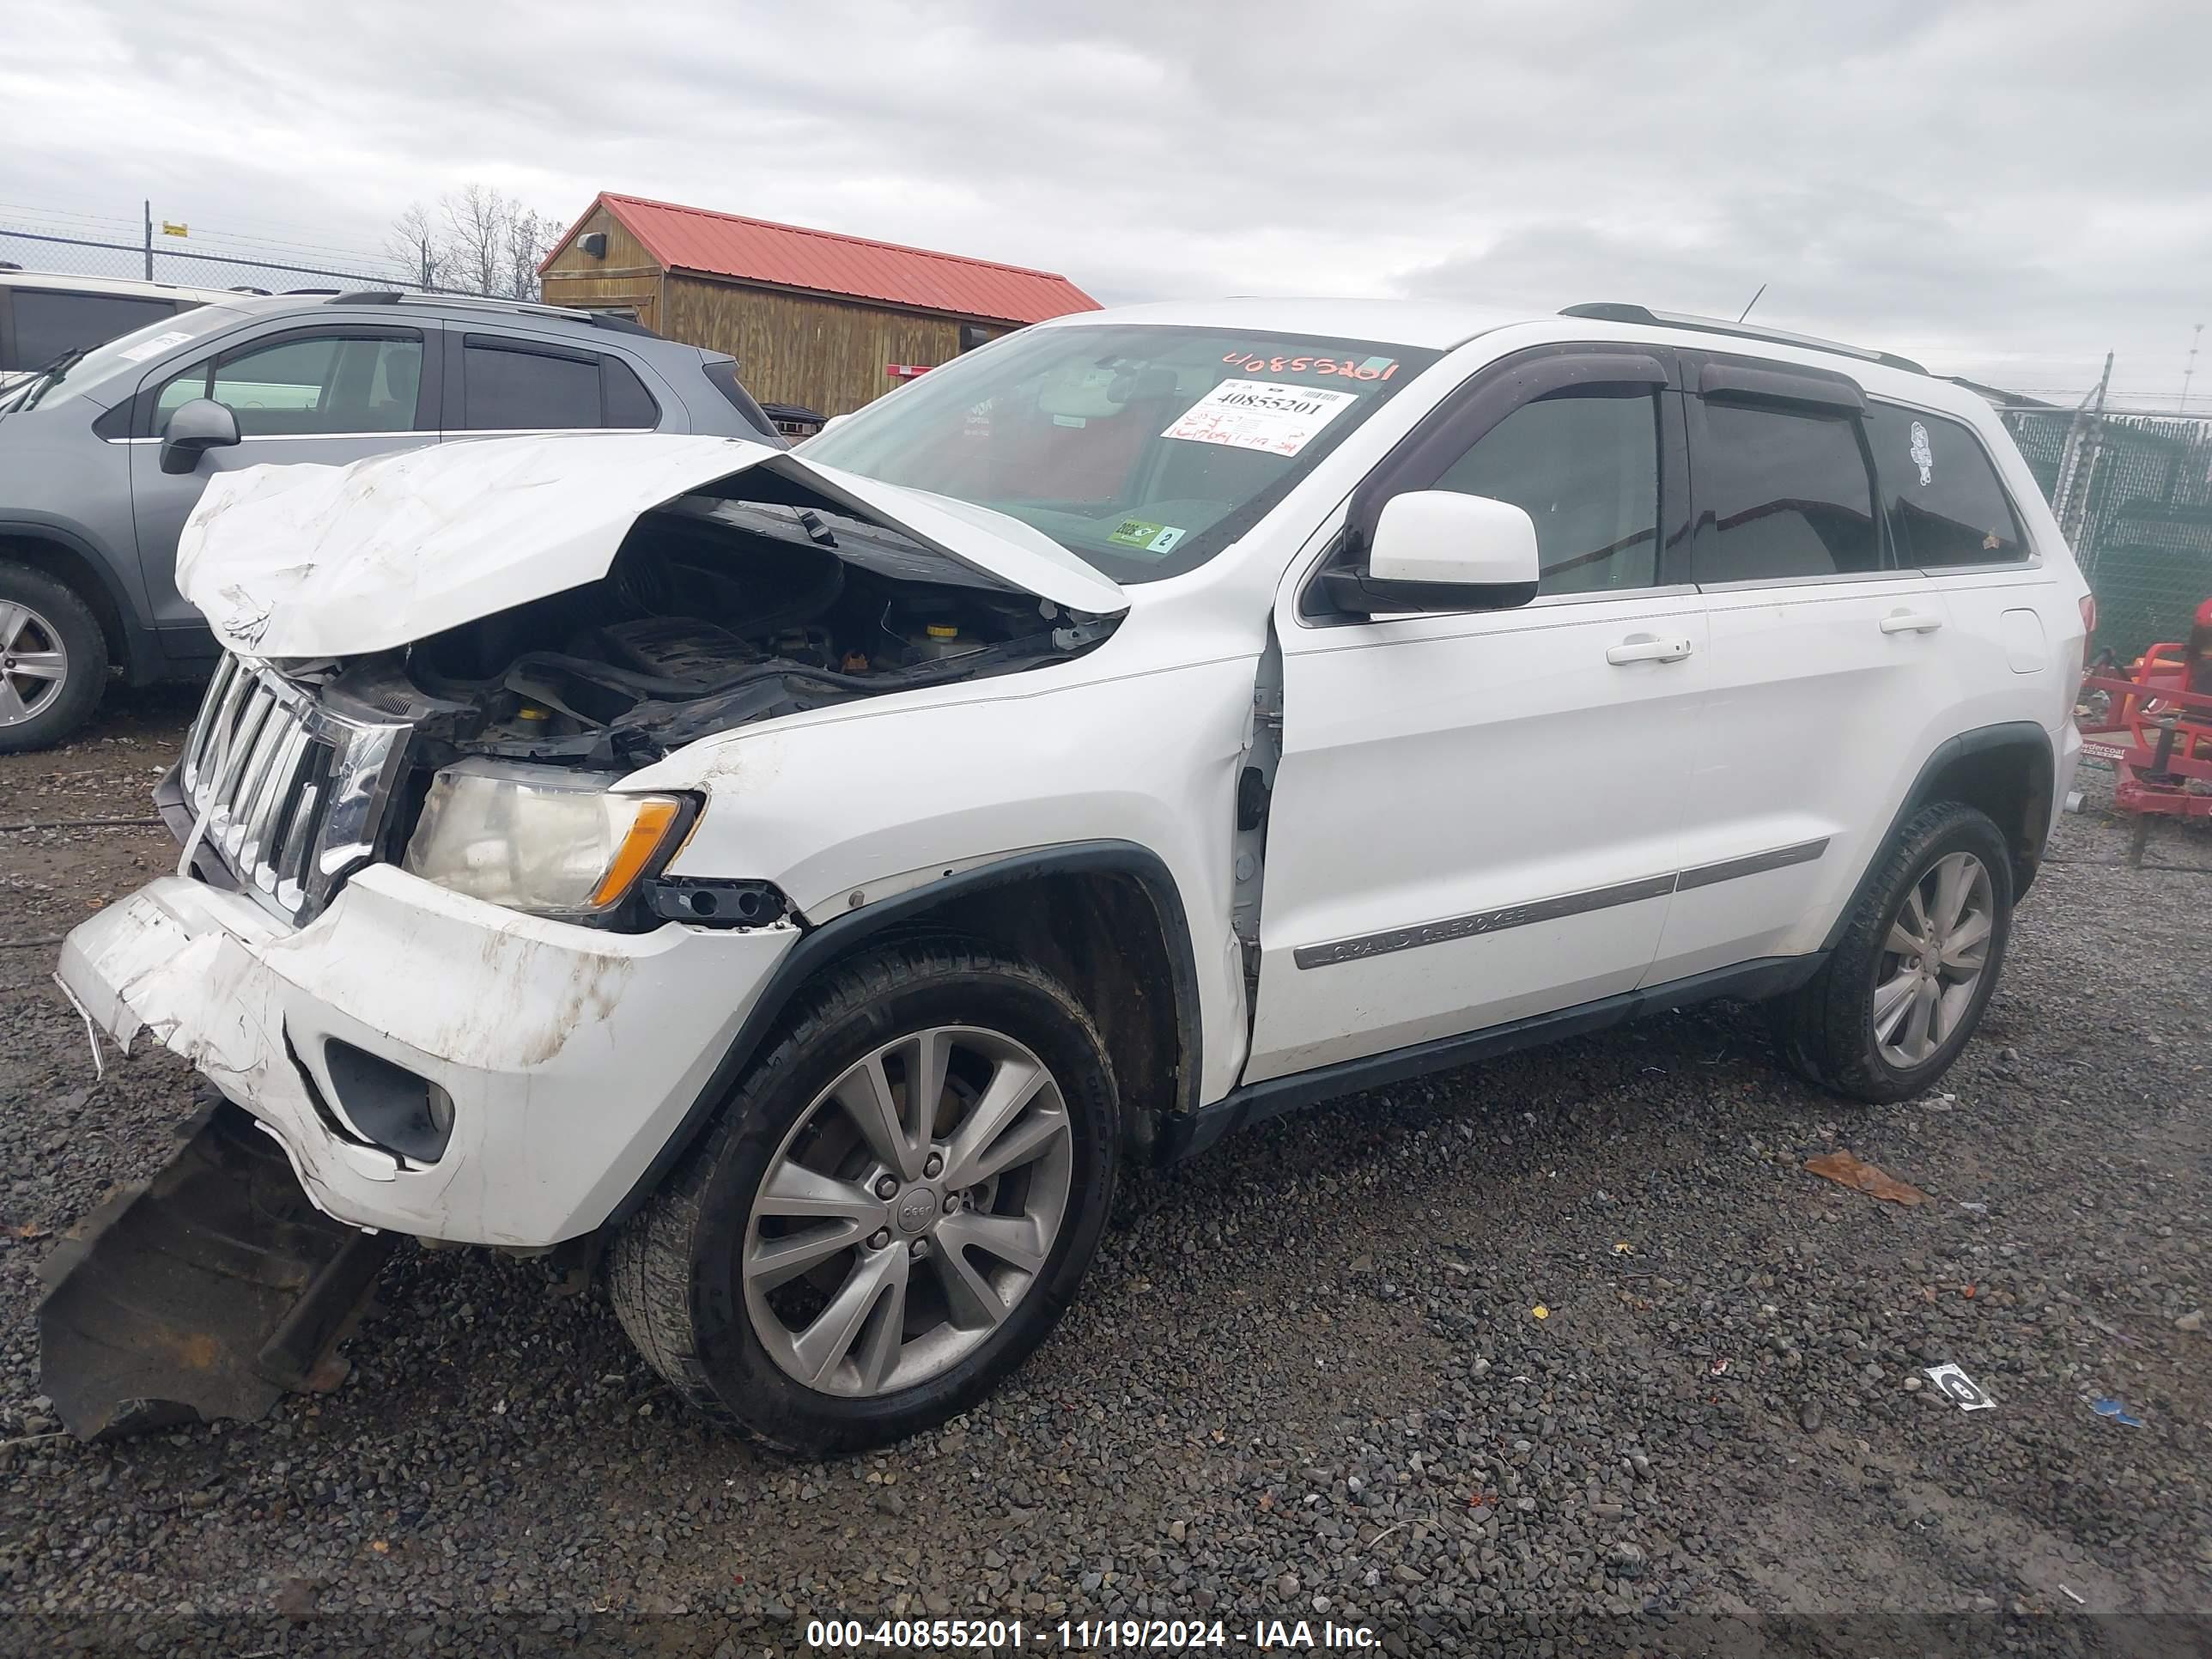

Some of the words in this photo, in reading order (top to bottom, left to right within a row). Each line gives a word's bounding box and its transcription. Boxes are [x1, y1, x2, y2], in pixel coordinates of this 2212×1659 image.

[1222, 352, 1400, 381] 40855201
[1216, 392, 1323, 416] 40855201
[1158, 532, 1174, 547] 2
[1333, 932, 1411, 961] GRAND
[1420, 908, 1527, 943] CHEROKEE
